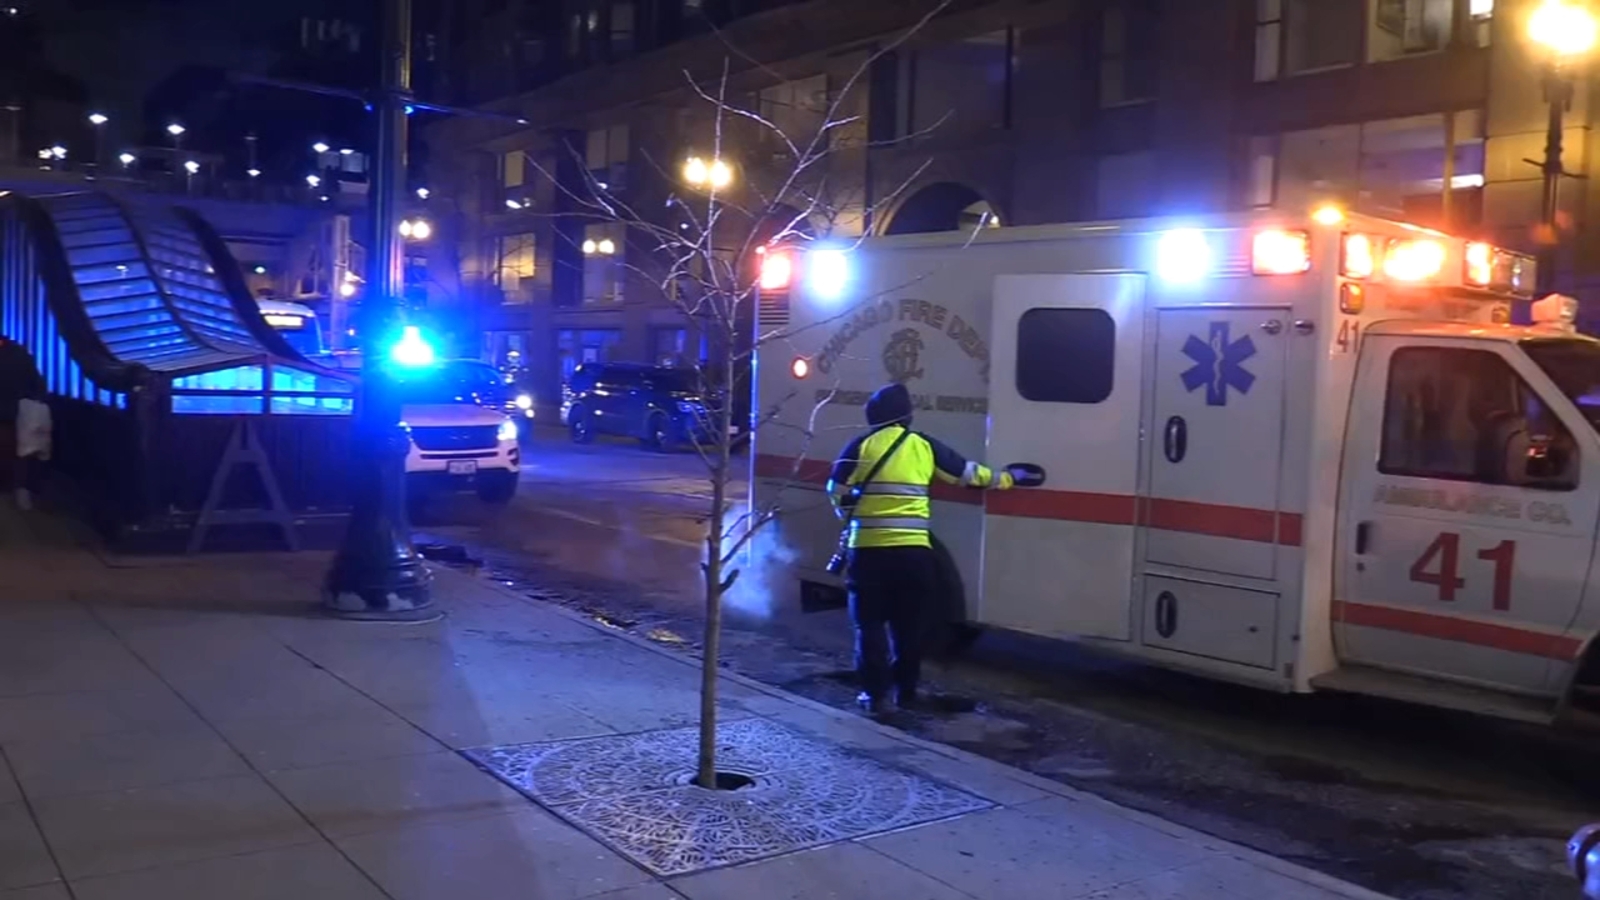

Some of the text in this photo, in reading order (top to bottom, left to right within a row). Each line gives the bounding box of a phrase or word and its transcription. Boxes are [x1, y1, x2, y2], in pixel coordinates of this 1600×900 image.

[817, 300, 893, 375] CHICAGO
[898, 298, 948, 330] FIRE
[1336, 319, 1360, 353] 41
[1409, 531, 1516, 611] 41
